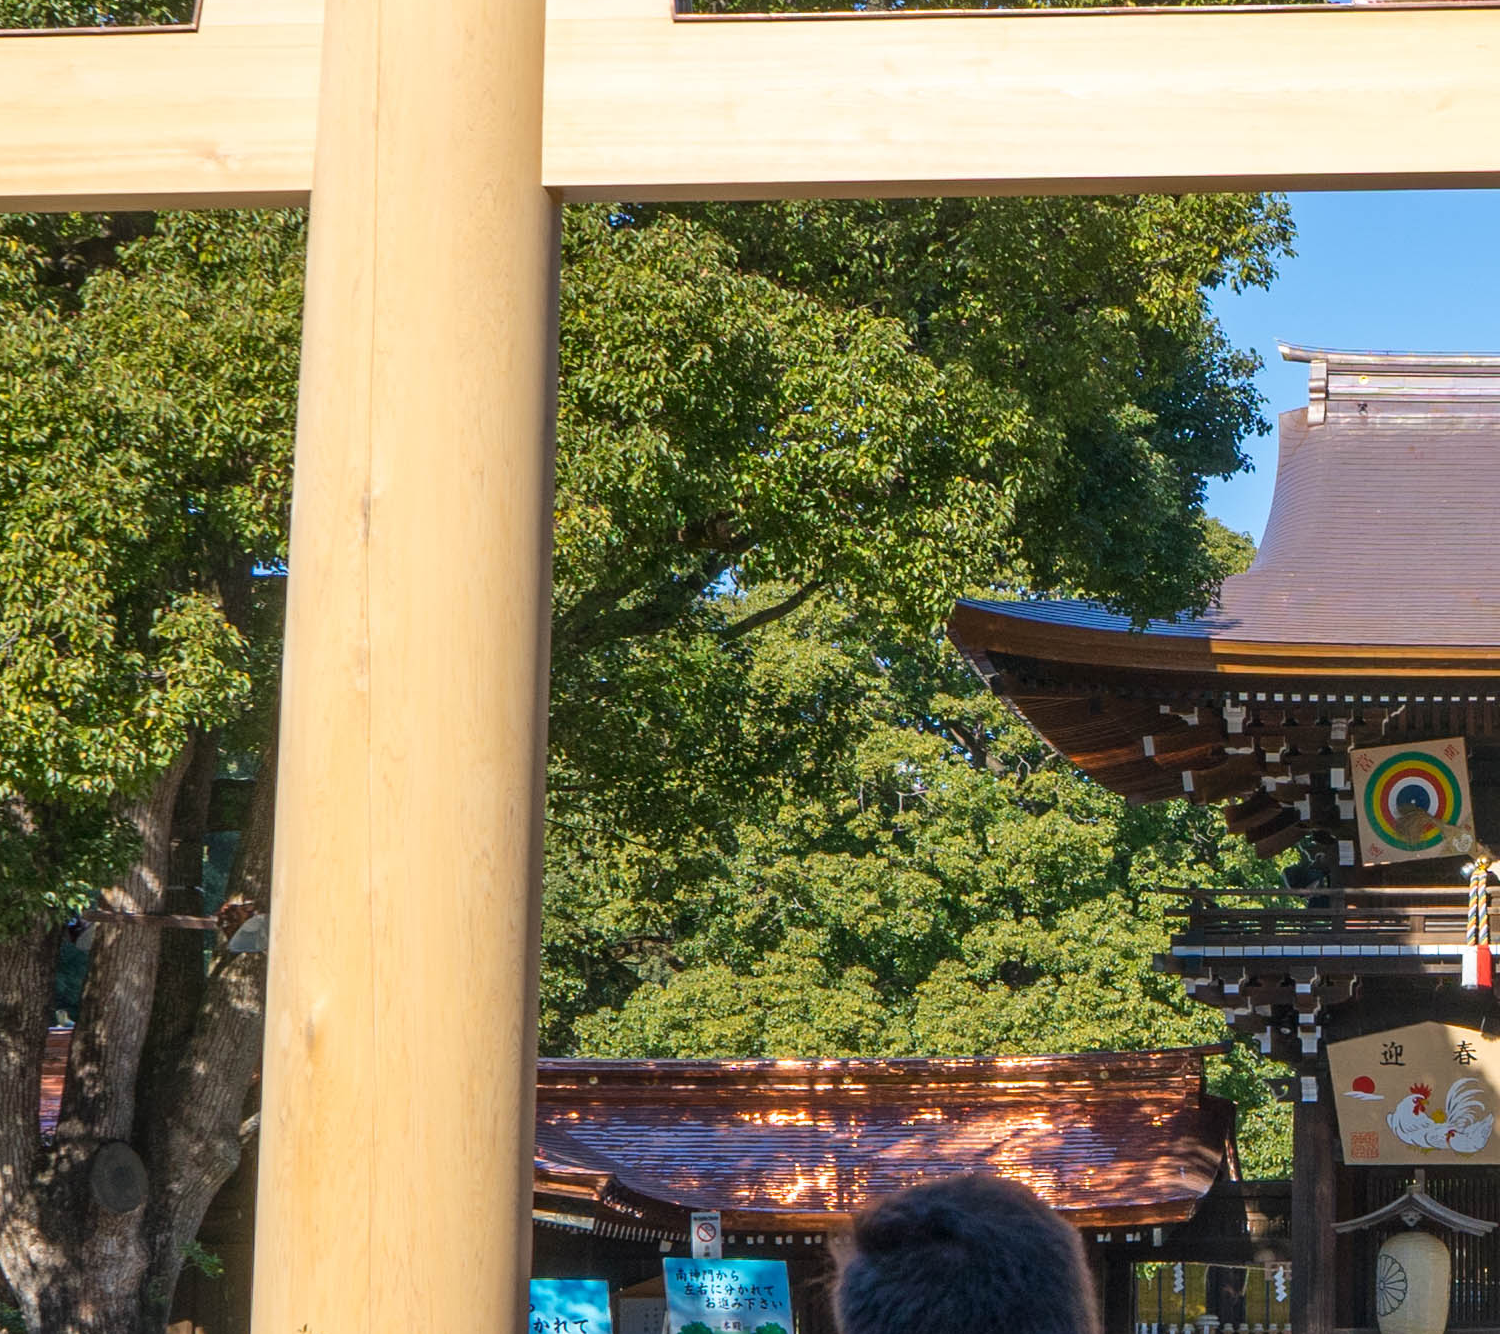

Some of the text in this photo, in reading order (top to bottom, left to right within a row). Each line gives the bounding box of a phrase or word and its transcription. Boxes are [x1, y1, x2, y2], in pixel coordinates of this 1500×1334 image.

[1380, 1040, 1478, 1066] 迎春
[675, 1268, 739, 1282] 南神門から
[684, 1283, 774, 1296] 左右に分かれて
[706, 1298, 783, 1310] お進み下さい
